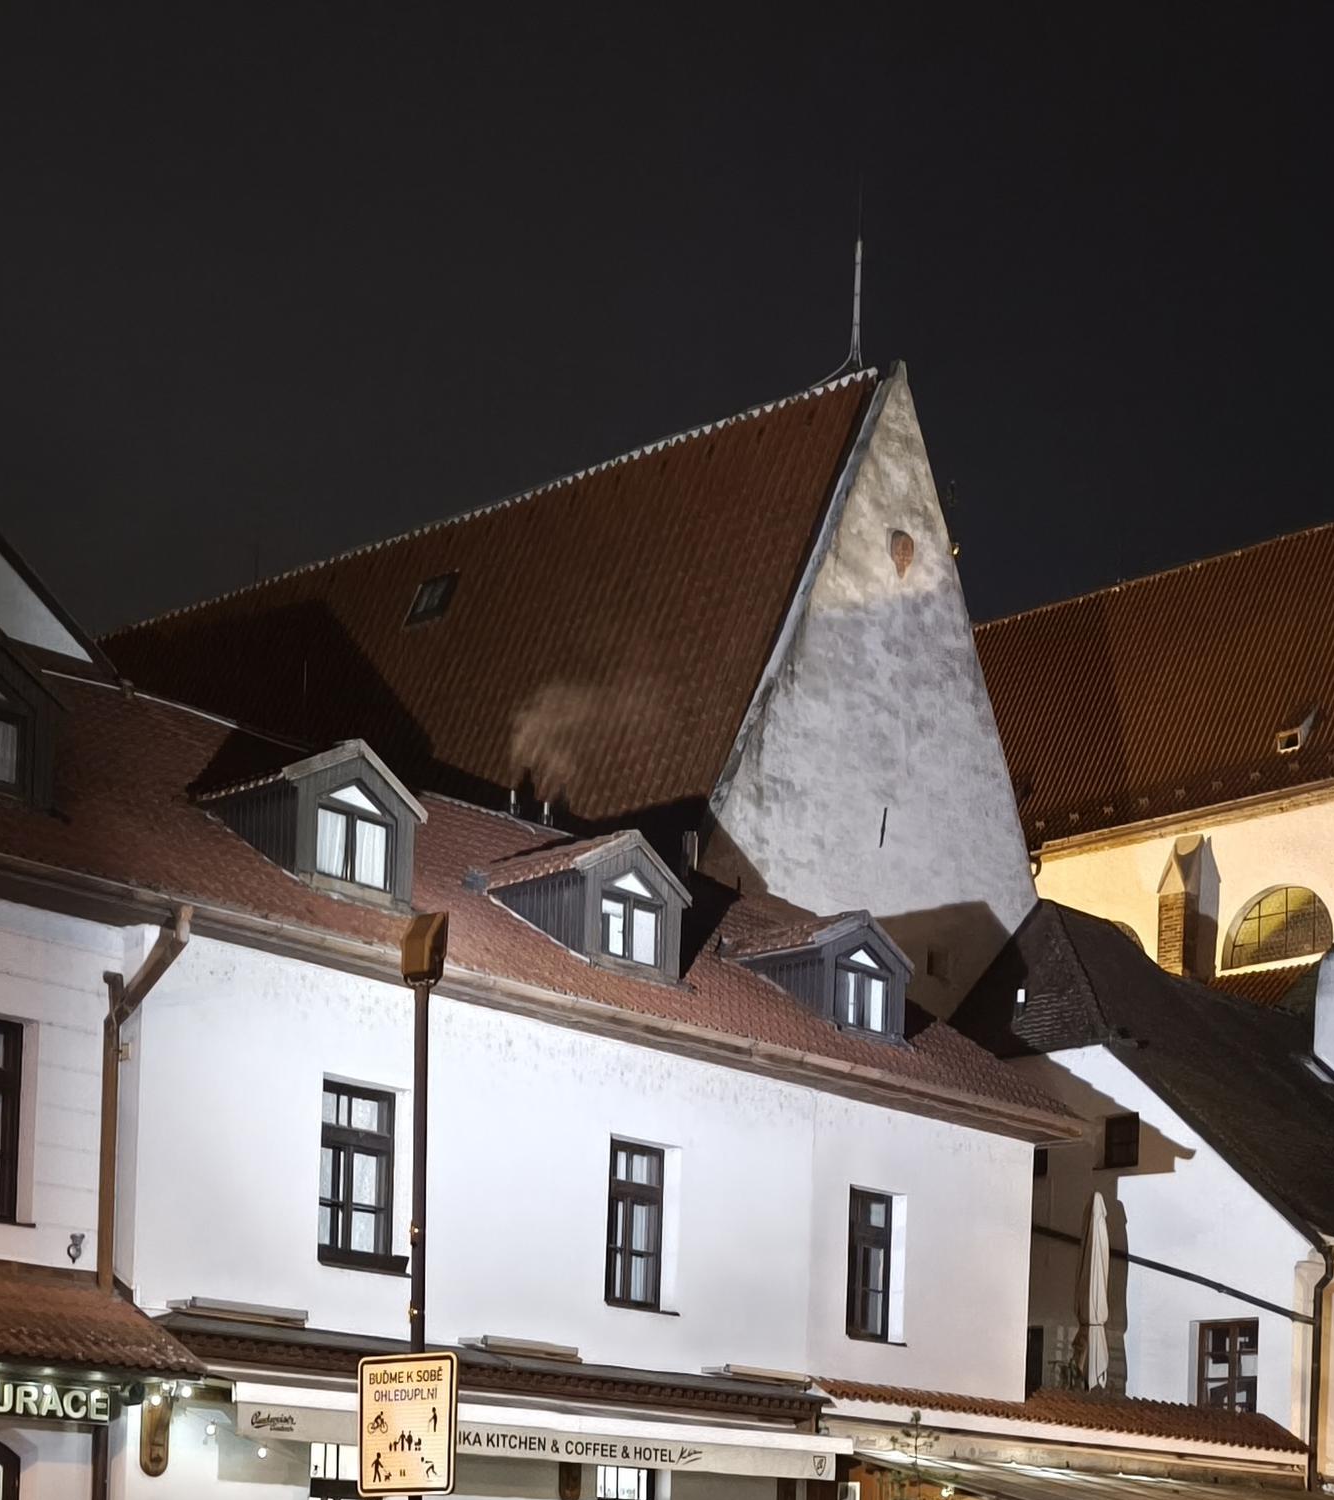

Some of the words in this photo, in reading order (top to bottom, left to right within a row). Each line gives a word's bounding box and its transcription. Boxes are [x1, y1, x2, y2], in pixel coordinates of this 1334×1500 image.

[369, 1370, 404, 1385] BUĎME
[407, 1371, 414, 1383] K
[416, 1366, 443, 1383] SOBĚ
[374, 1384, 438, 1402] OHLEDUPLNÍ
[458, 1431, 482, 1447] IKA
[486, 1433, 547, 1452] KITCHEN
[551, 1439, 560, 1454] &
[565, 1440, 617, 1459] COFFEE
[621, 1445, 631, 1459] &
[634, 1446, 676, 1464] HOTEL
